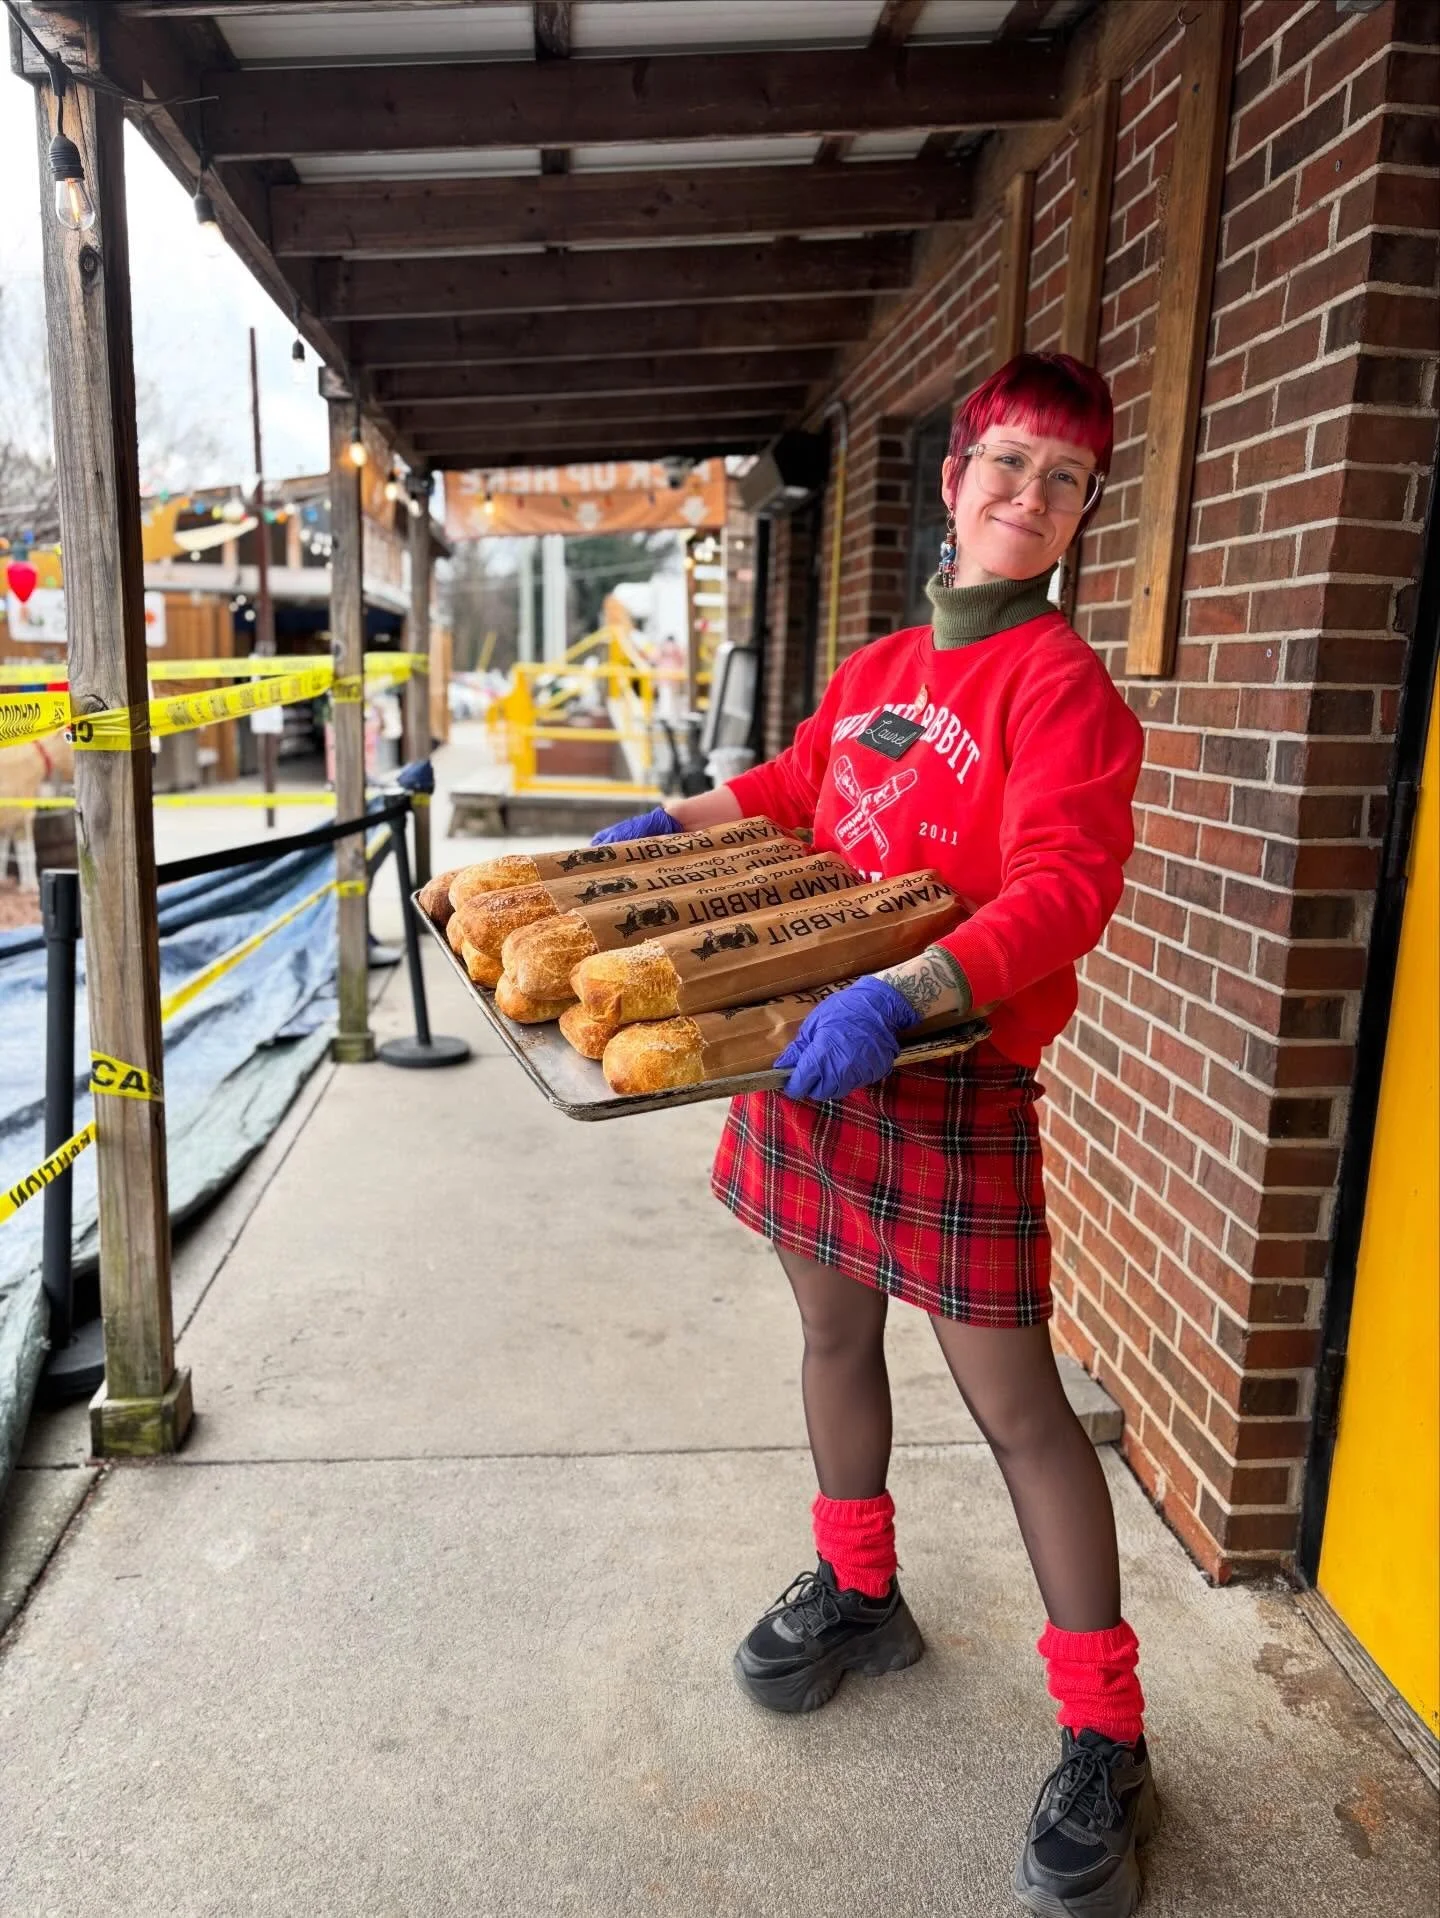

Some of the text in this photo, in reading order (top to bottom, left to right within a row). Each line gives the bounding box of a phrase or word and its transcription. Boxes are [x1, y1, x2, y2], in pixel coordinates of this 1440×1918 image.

[865, 719, 914, 748] Laurel
[919, 822, 958, 846] 2011
[626, 836, 714, 862] RABBIT
[727, 849, 760, 861] and
[647, 865, 739, 891] RABBIT
[656, 857, 725, 874] Grocery
[696, 859, 846, 895] Cafe and Grocery
[893, 873, 936, 889] Cafe
[688, 886, 783, 925] RABBIT
[854, 888, 890, 903] and
[768, 907, 871, 946] RABBIT
